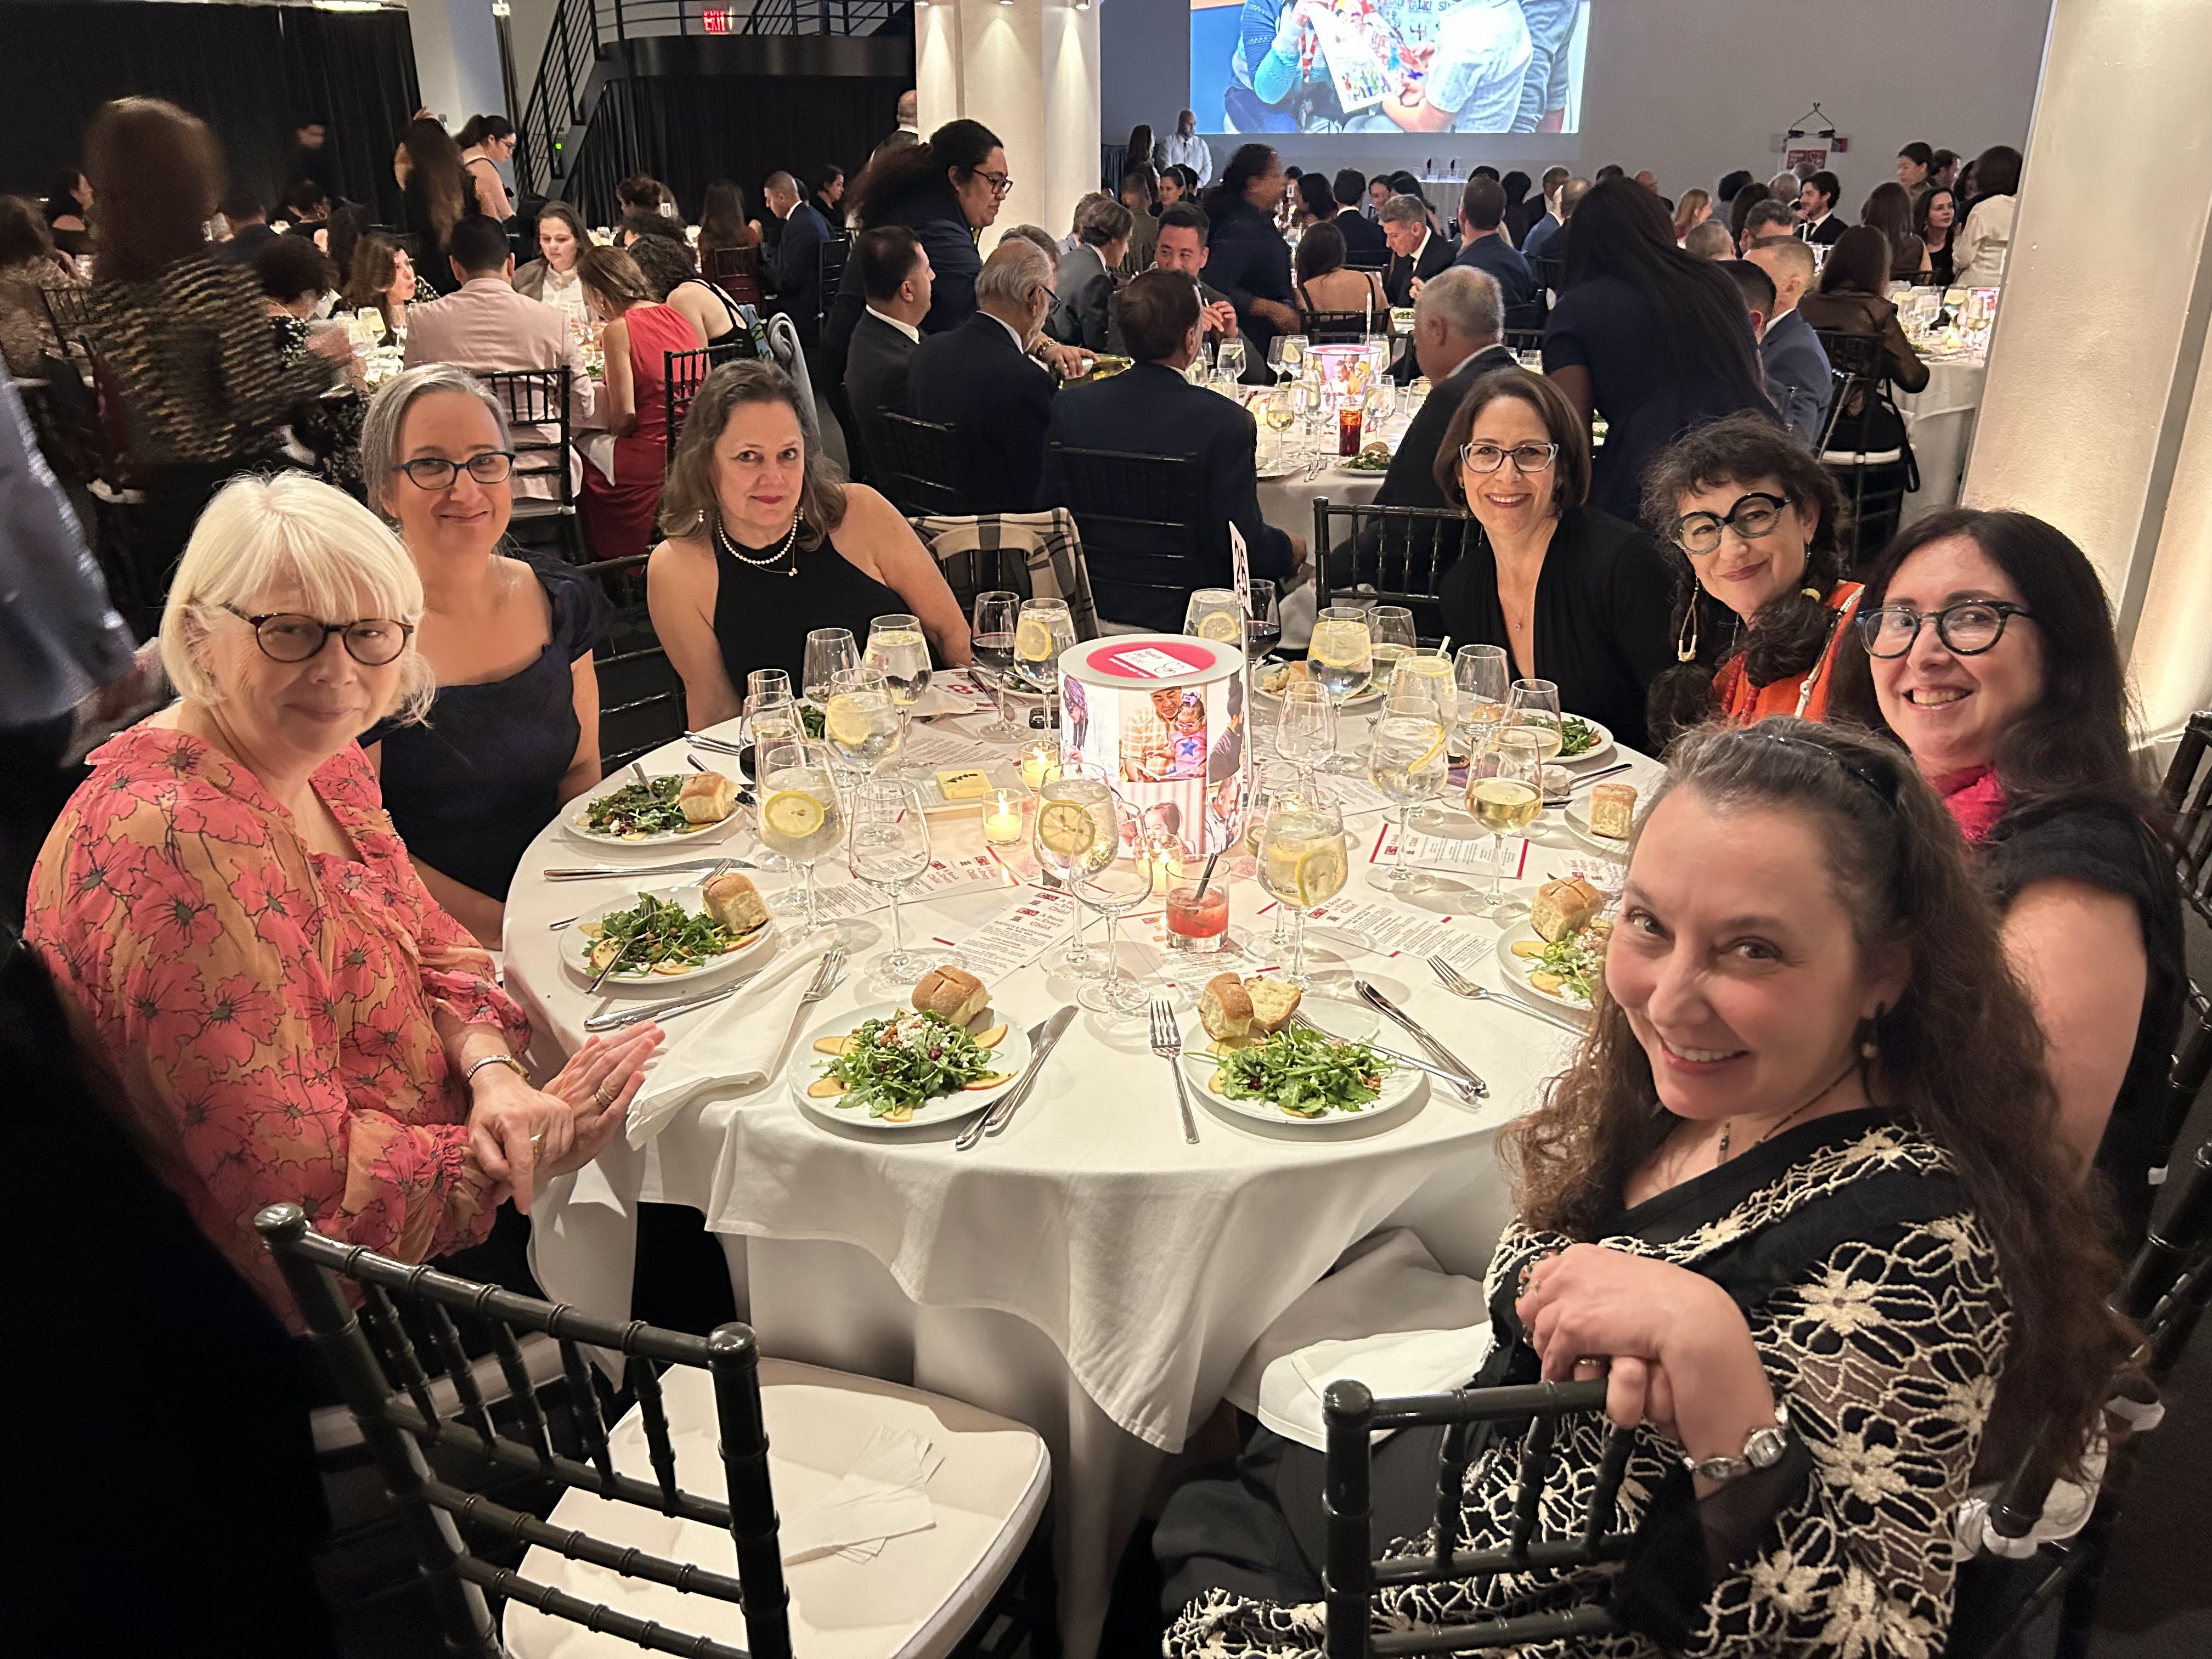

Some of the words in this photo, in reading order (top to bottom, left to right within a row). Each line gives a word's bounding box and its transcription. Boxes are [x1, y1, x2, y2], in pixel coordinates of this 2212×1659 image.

[703, 10, 725, 31] EXIT
[1234, 540, 1248, 596] 26
[1048, 906, 1070, 915] Child
[1042, 919, 1063, 927] Every
[1047, 915, 1065, 923] Book
[1030, 921, 1052, 930] Child
